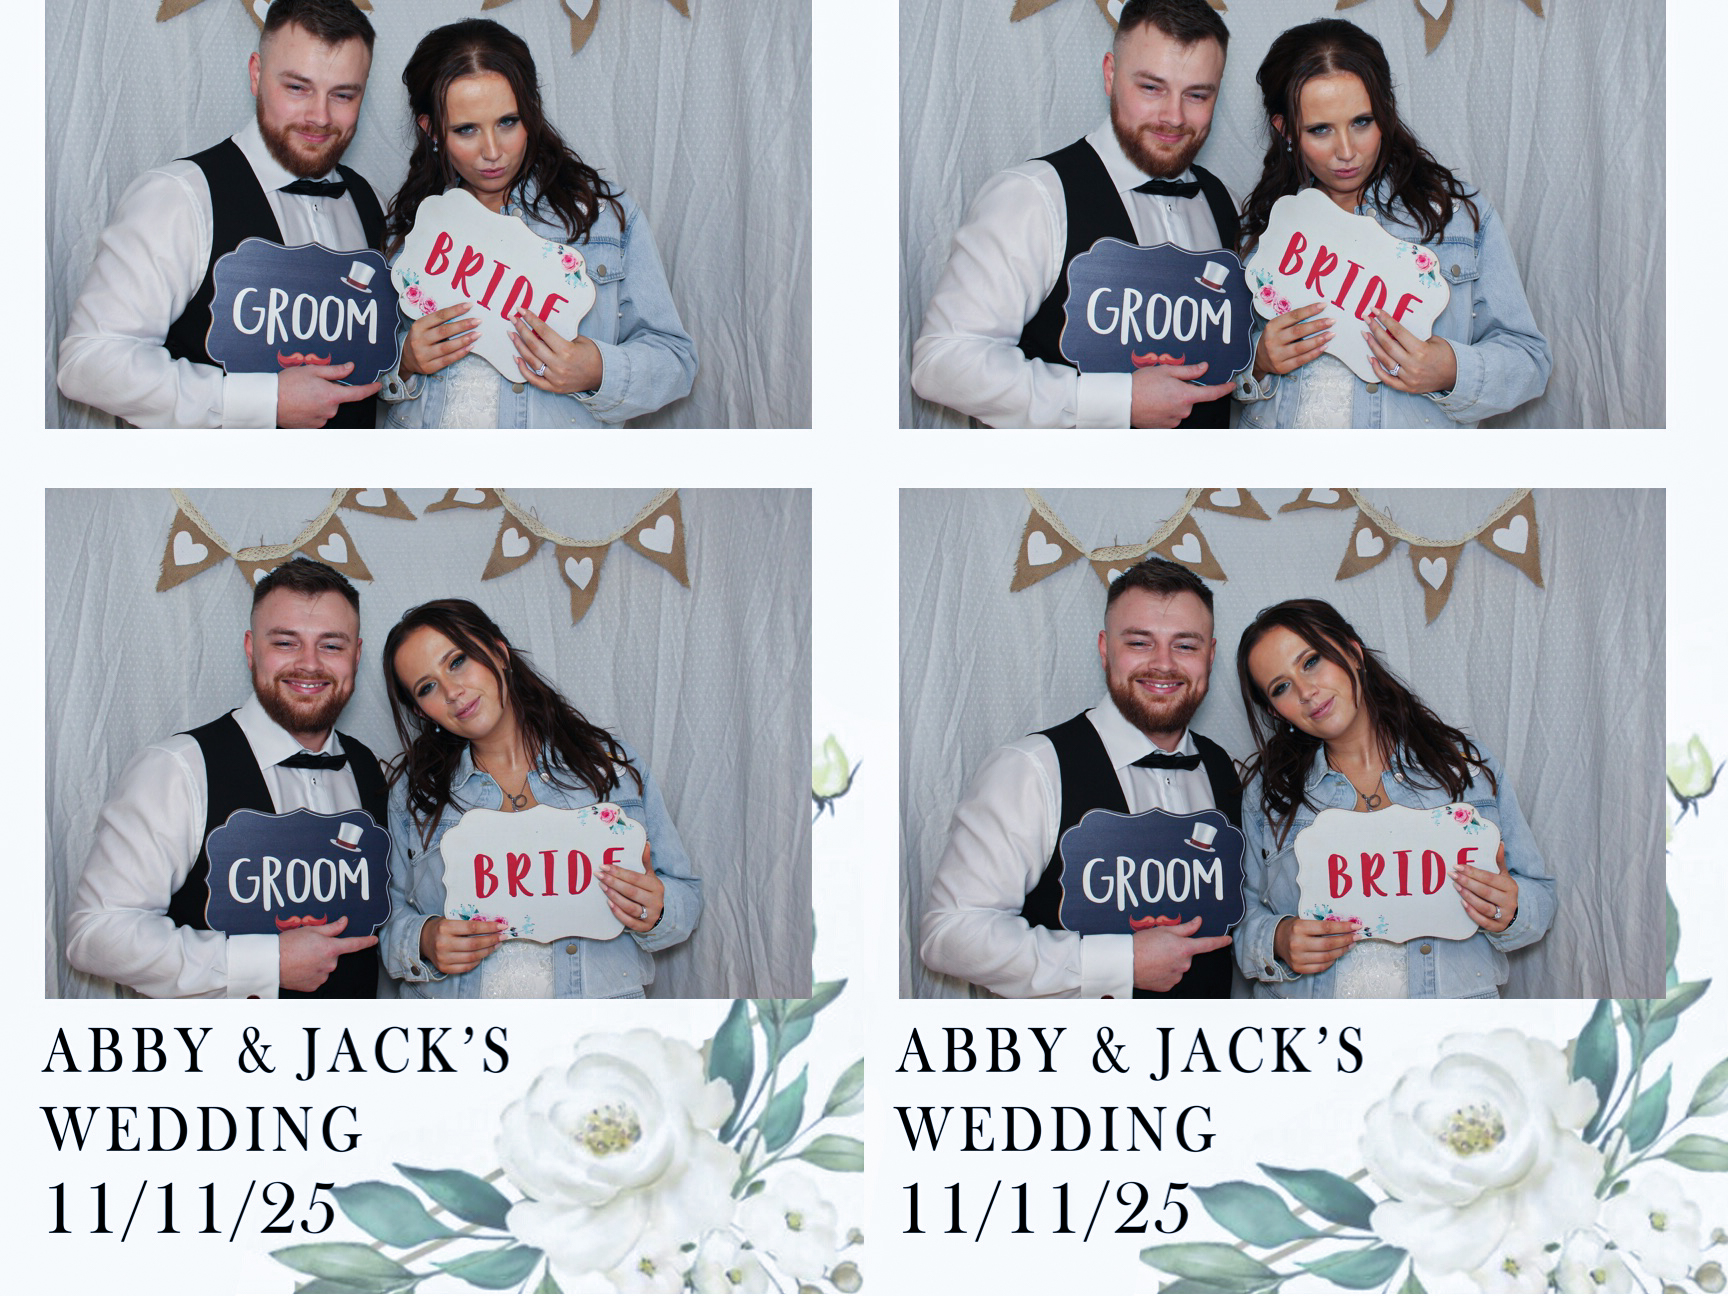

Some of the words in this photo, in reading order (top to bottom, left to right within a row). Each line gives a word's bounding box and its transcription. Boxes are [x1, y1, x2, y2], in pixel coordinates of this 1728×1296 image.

[232, 287, 378, 345] GROOM
[1086, 287, 1232, 345] GROOM
[228, 855, 370, 912] GROOM
[1082, 855, 1224, 912] GROOM
